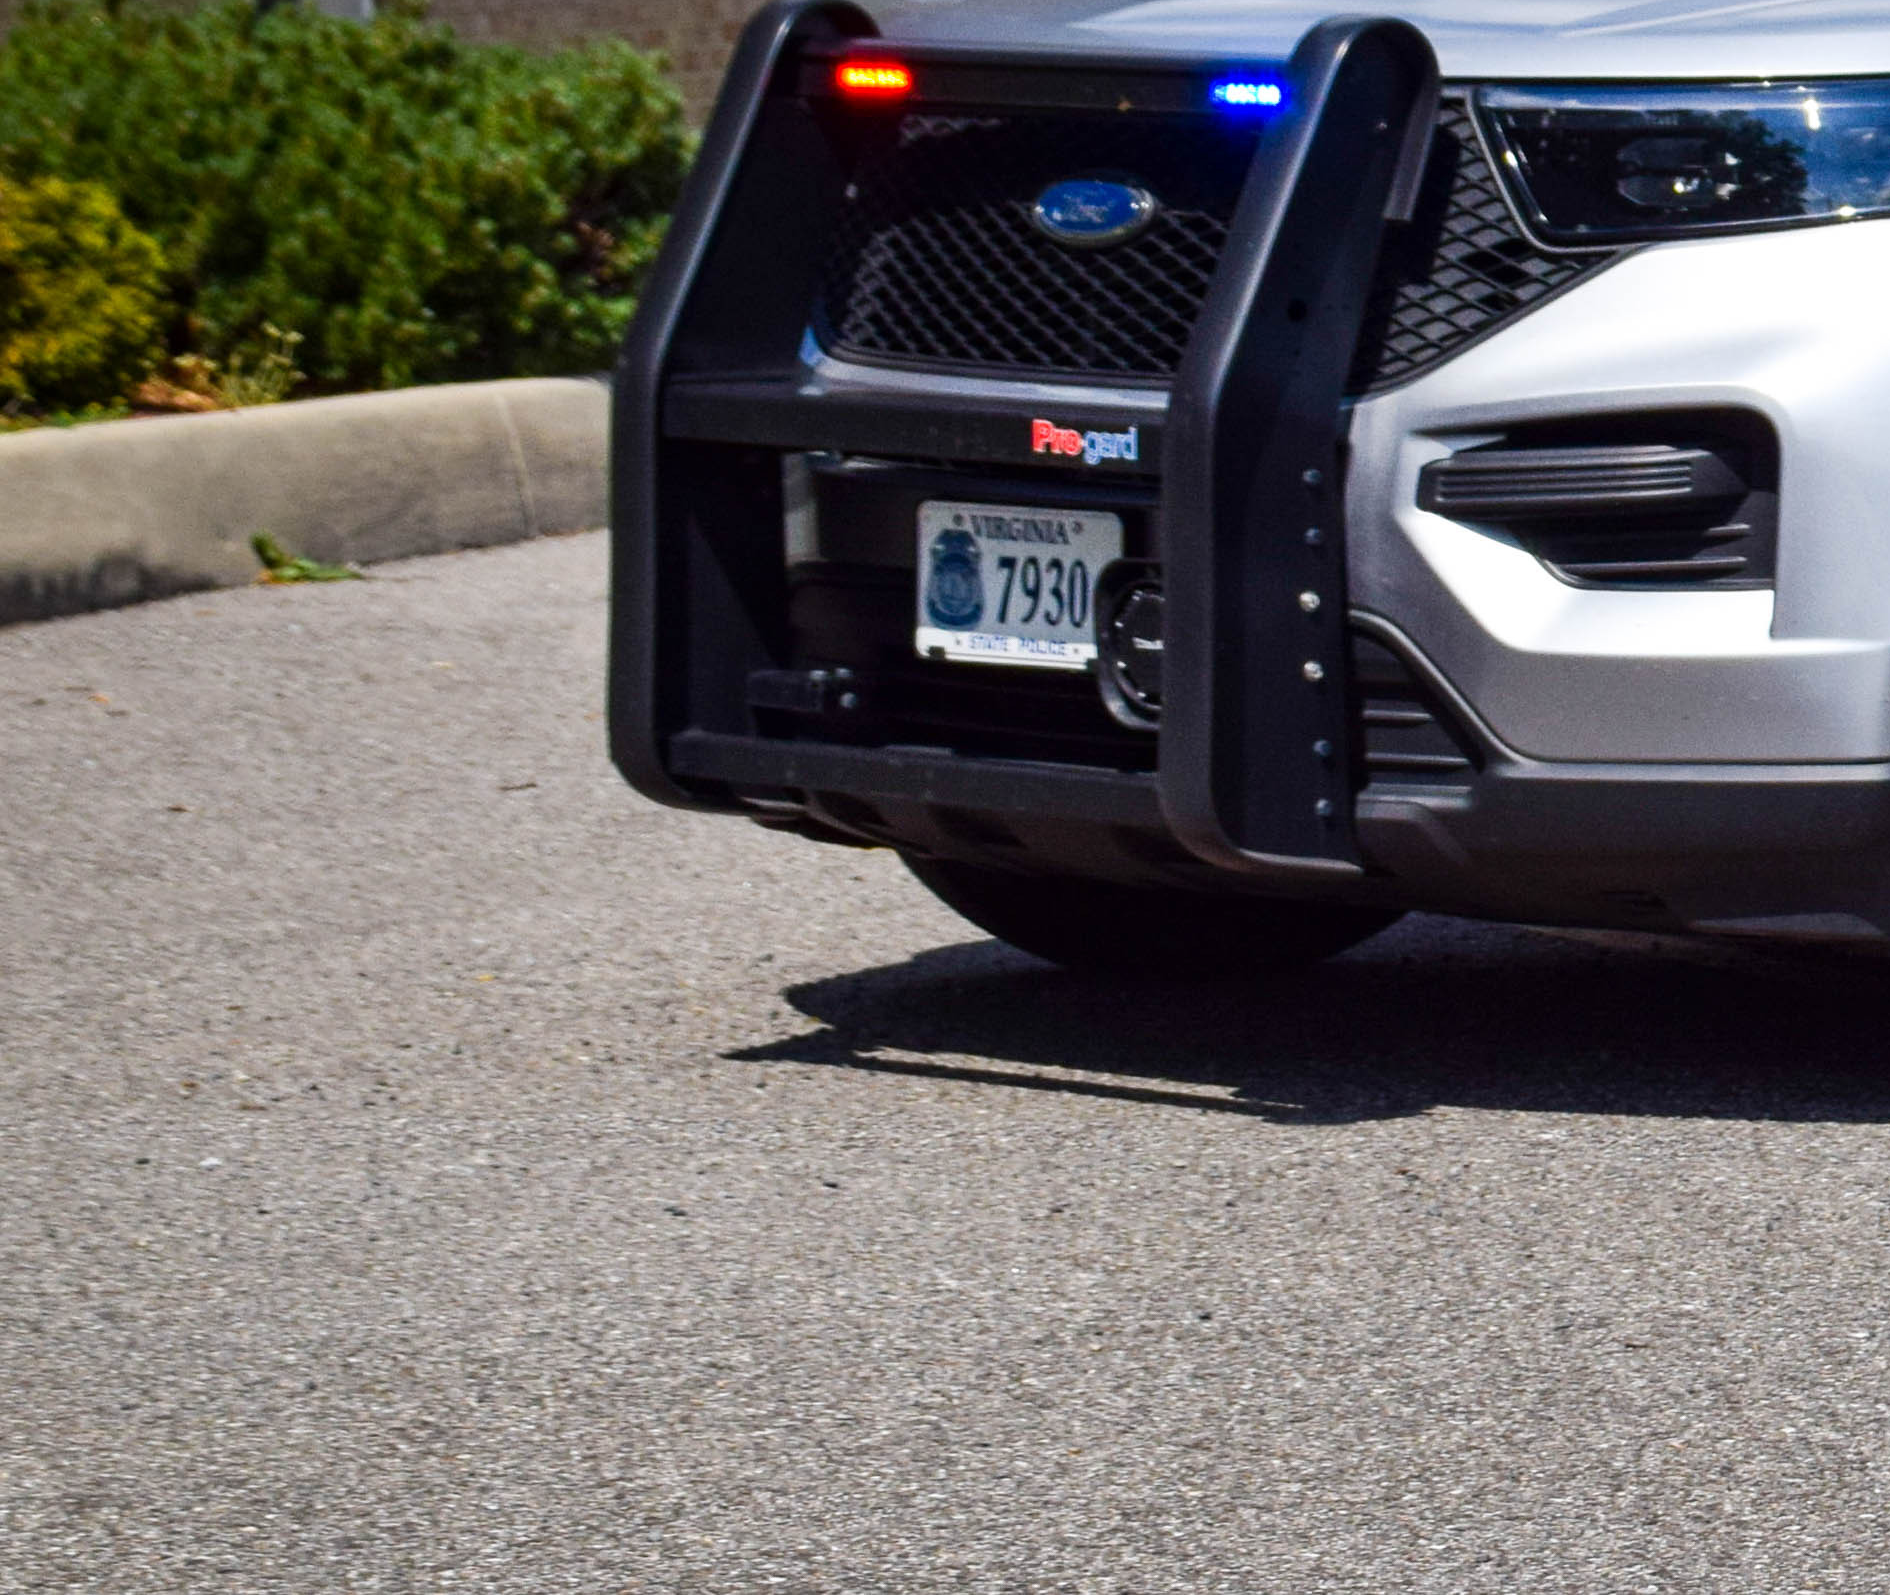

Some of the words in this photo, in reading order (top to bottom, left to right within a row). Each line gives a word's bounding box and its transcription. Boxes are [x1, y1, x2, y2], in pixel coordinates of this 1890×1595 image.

[969, 514, 1072, 546] VIRGINIA
[996, 555, 1089, 629] 7930
[967, 634, 1010, 653] STATE
[1018, 636, 1068, 657] POLICE
